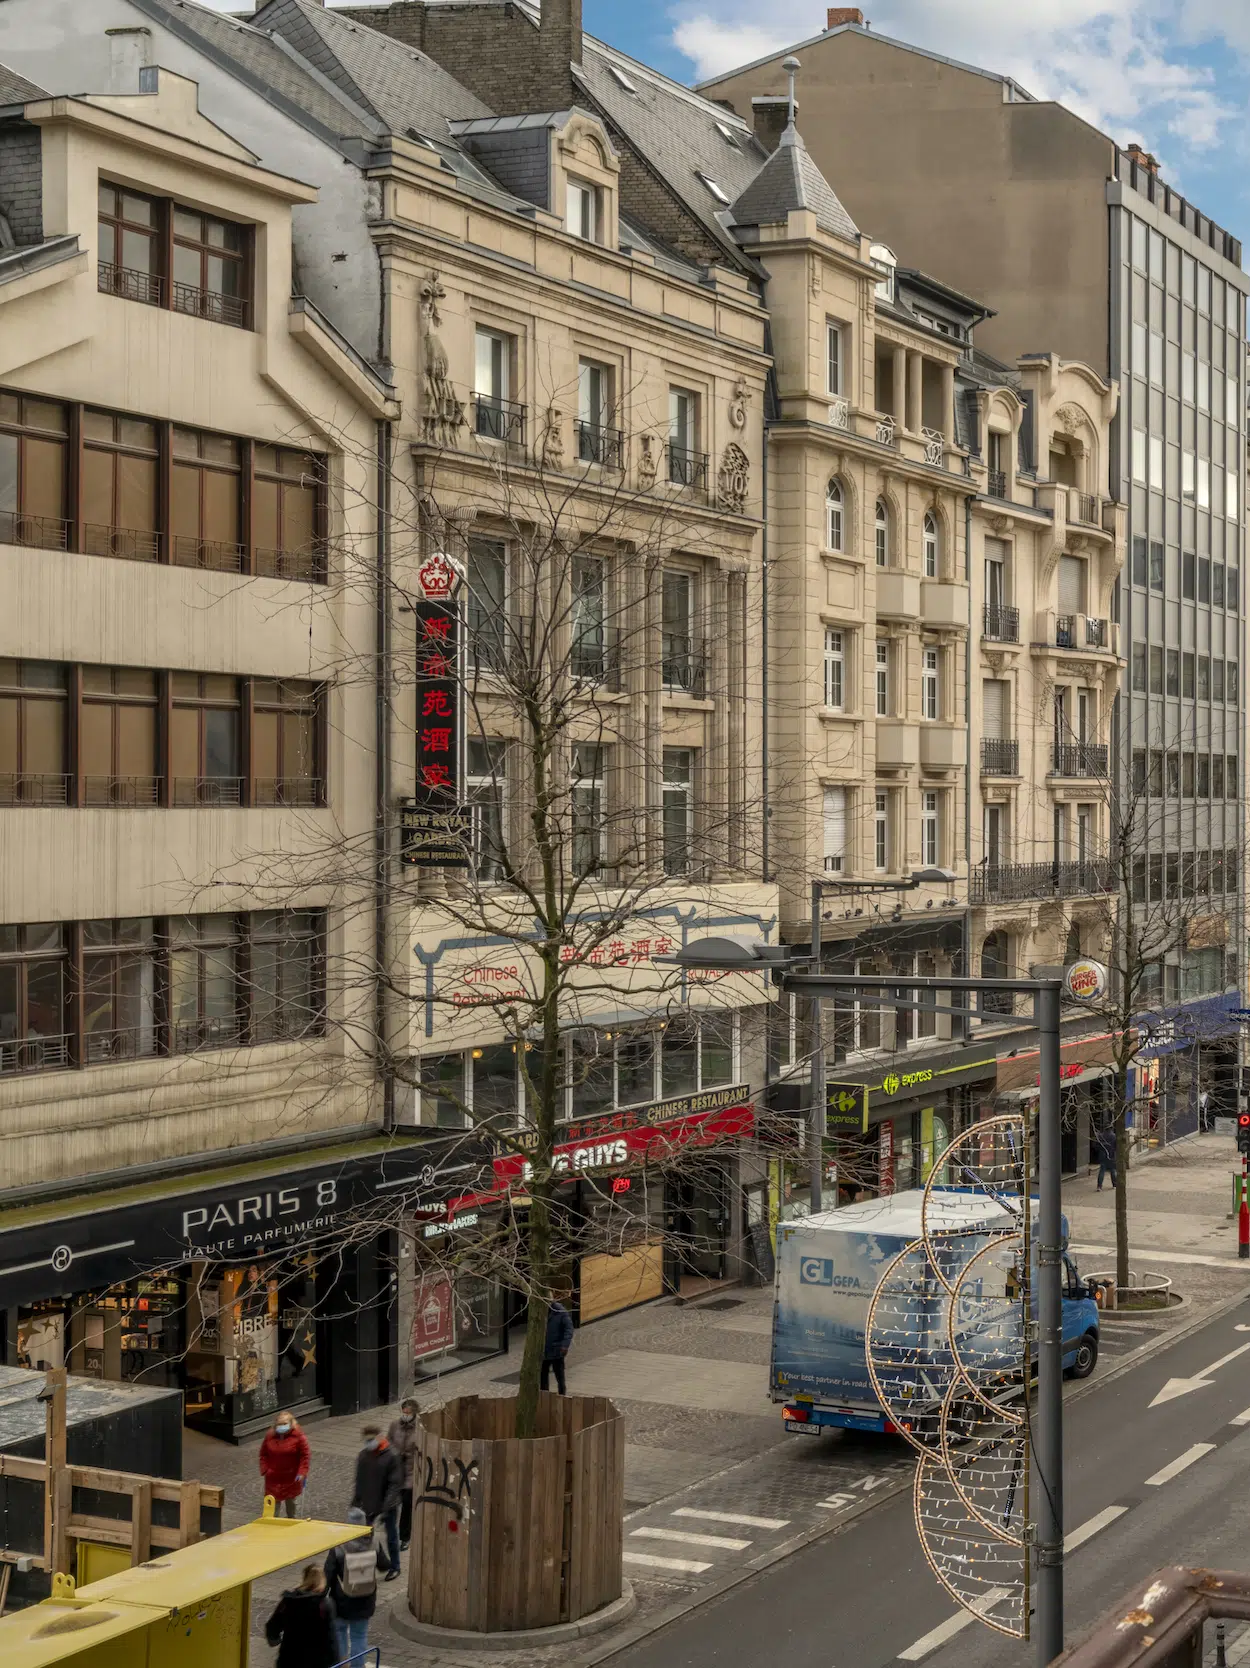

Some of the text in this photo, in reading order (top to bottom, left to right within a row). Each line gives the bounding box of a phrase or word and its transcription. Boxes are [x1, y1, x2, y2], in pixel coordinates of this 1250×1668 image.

[463, 964, 518, 985] Chinese
[1071, 970, 1097, 983] BURGER
[1072, 976, 1098, 992] KING
[902, 1069, 933, 1088] express
[647, 1087, 748, 1120] CHINESE RESTAURANT
[825, 1114, 860, 1125] express
[573, 1139, 628, 1171] GUYS
[183, 1179, 337, 1238] PARIS 8
[182, 1214, 337, 1260] HAUTE PARFUMERIE
[802, 1259, 831, 1283] GL
[833, 1275, 860, 1289] GEPA
[782, 1371, 801, 1381] Your
[801, 1372, 815, 1382] best
[815, 1375, 841, 1385] partner
[842, 1378, 851, 1386] in
[852, 1379, 868, 1389] road
